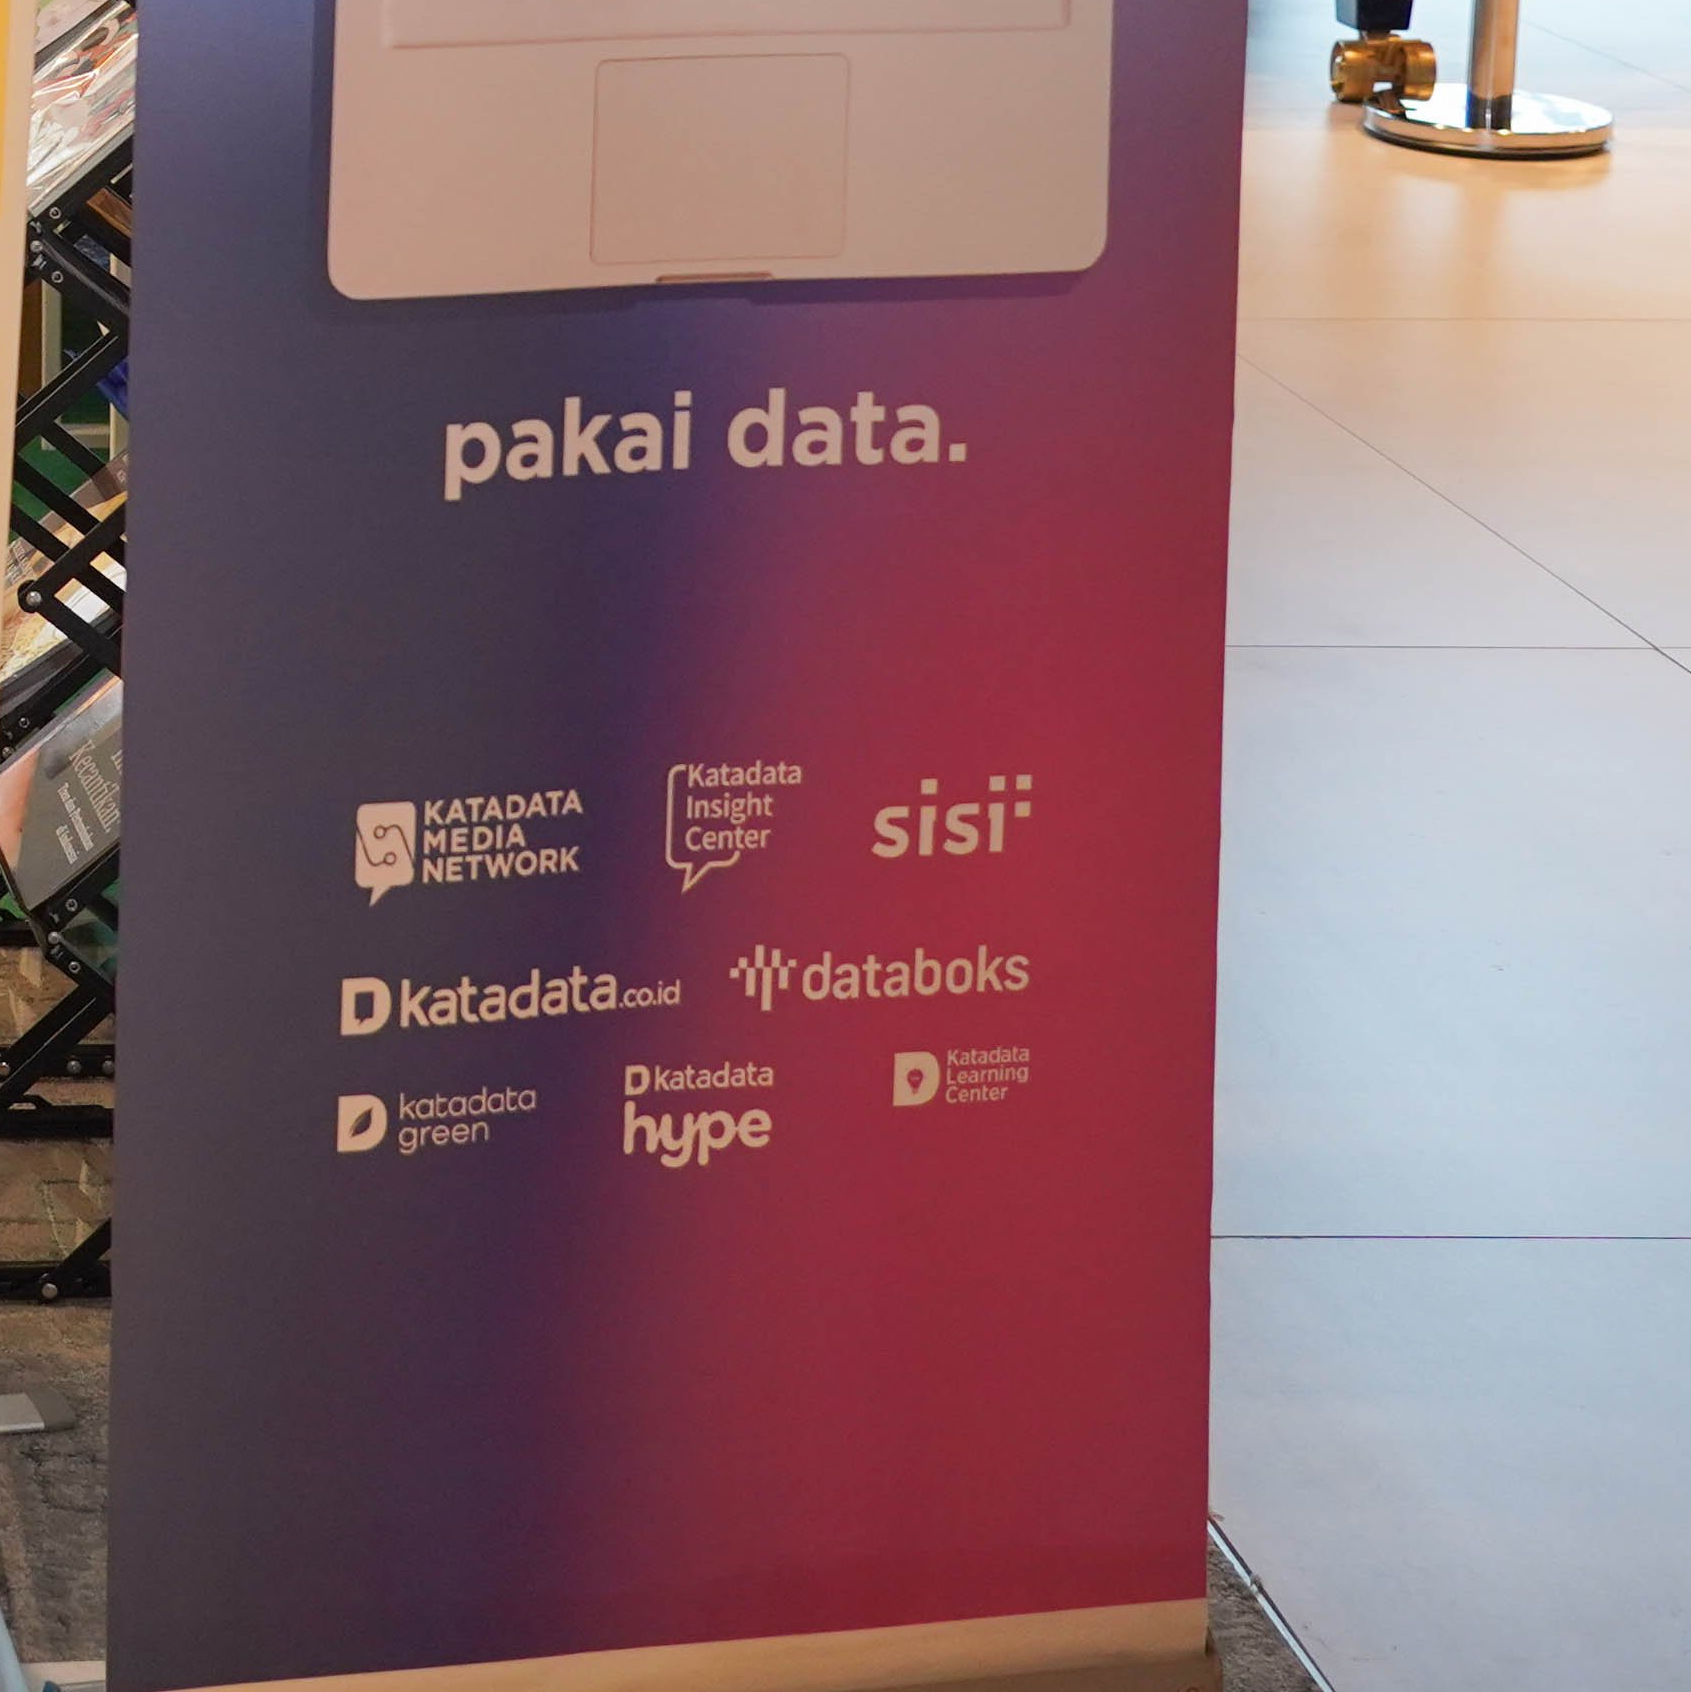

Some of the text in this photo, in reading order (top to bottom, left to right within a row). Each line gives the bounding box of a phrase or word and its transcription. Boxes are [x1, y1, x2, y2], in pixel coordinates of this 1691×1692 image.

[442, 387, 969, 502] pakai data.
[687, 760, 803, 789] Katadata
[423, 789, 584, 826] KATADATA
[686, 792, 774, 824] Insight
[423, 823, 527, 855] MEDIA
[685, 825, 771, 853] Center
[422, 846, 582, 885] NETWORK
[801, 944, 1031, 1000] databoks
[399, 965, 681, 1028] katadata.co.id
[946, 1046, 1030, 1067] Katadata
[654, 1061, 775, 1092] katadata
[946, 1065, 1029, 1085] Learning
[398, 1086, 537, 1120] katadata
[945, 1085, 1008, 1104] Center
[398, 1121, 490, 1156] green
[623, 1100, 773, 1168] hype
